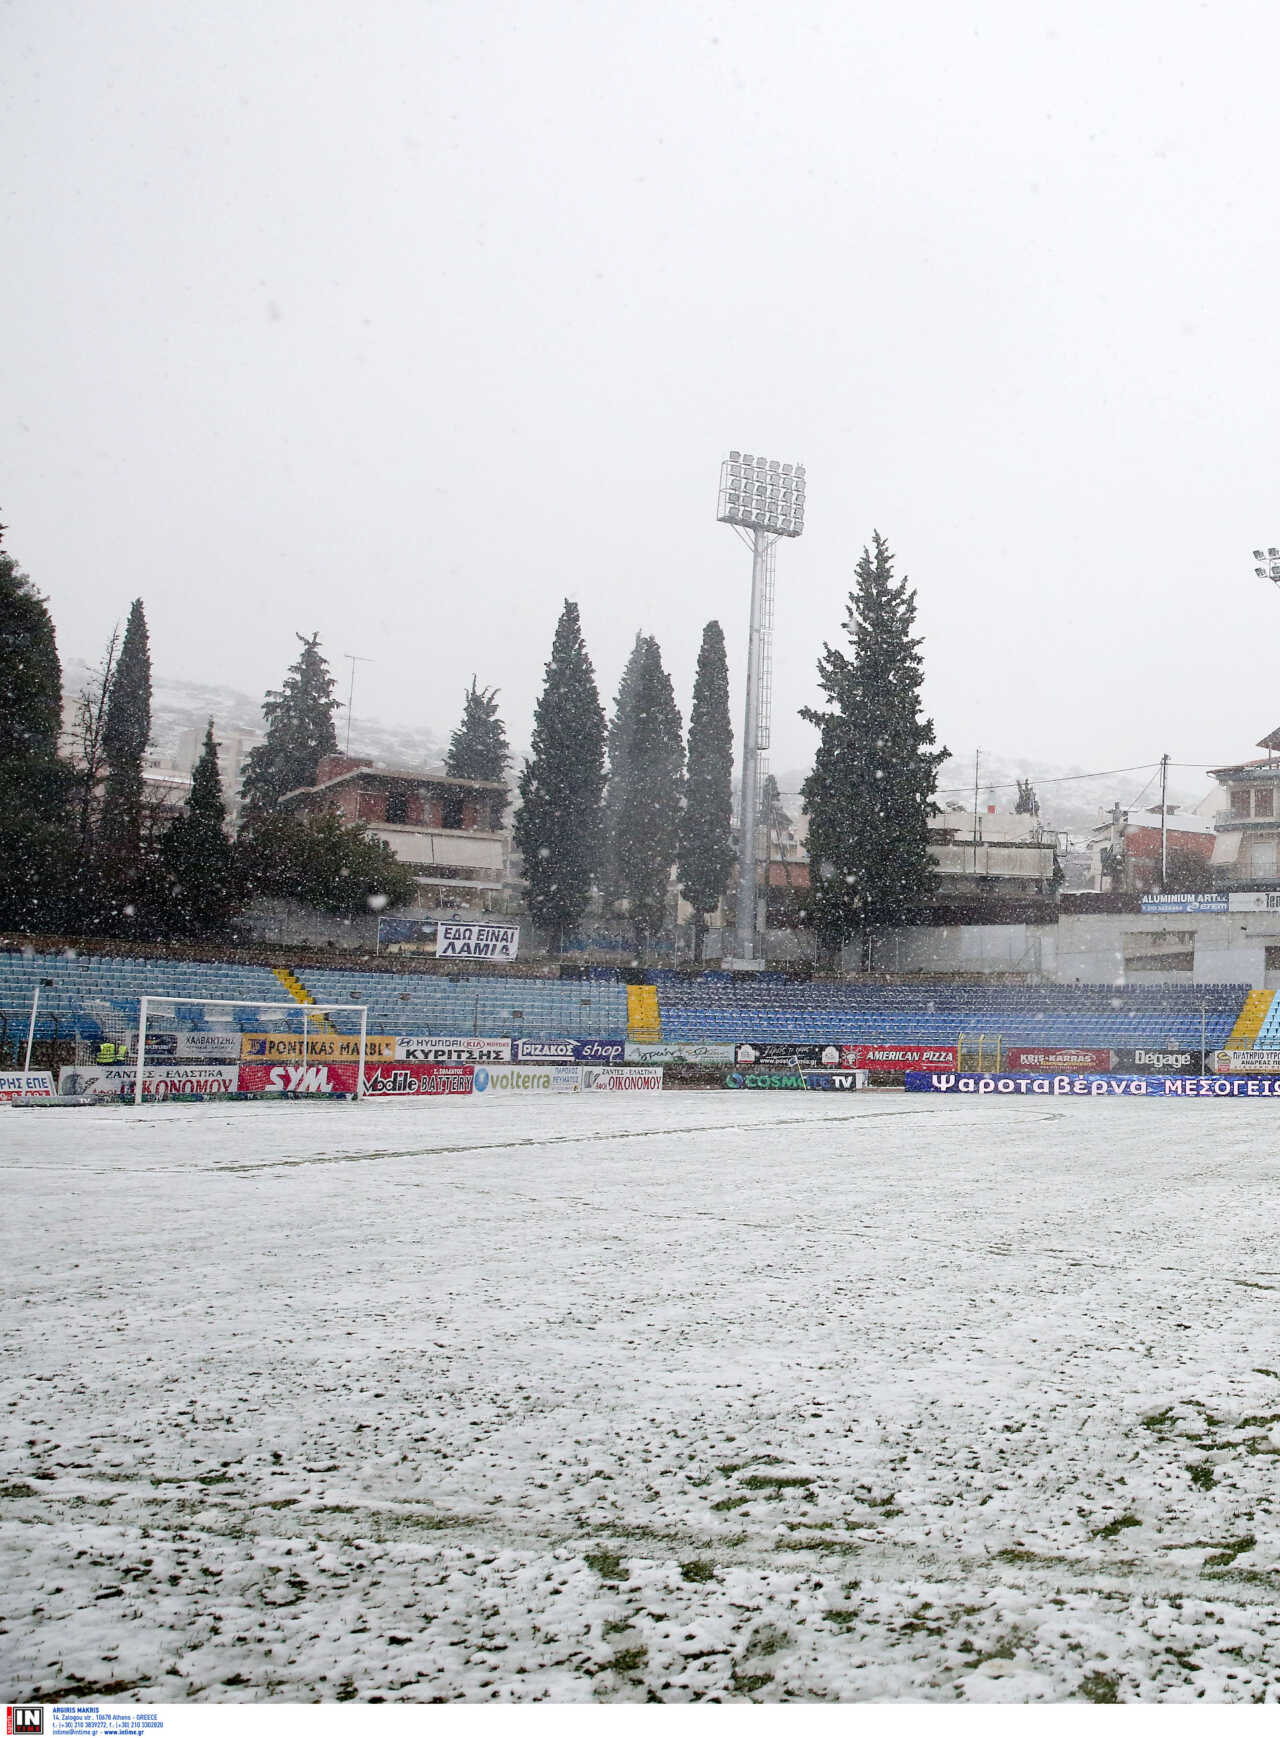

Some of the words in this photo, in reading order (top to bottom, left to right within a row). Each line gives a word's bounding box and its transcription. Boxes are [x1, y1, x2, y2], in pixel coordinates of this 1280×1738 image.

[1142, 894, 1195, 903] ALUMINIUM
[1198, 893, 1218, 902] ART
[443, 927, 473, 941] ΕΔΩ
[476, 927, 515, 943] ΕΙΝΑΙ
[268, 1040, 335, 1056] PONTIKAS
[416, 1039, 462, 1047] HYUNDAI
[522, 1045, 574, 1056] ΡΙΖΑΚΟΣ
[405, 1049, 505, 1060] ΚΥΡΙΤΣΗΣ
[582, 1044, 623, 1062] shop
[866, 1050, 921, 1062] AMERICAN
[922, 1051, 954, 1062] PIZZA
[165, 1069, 223, 1079] ΕΛΑΣΤΙΚΑ
[265, 1066, 334, 1093] SYM
[490, 1070, 550, 1090] volterra
[26, 1077, 49, 1089] ΕΠΕ
[420, 1075, 474, 1092] BATTERY
[608, 1075, 662, 1091] ΟΙΚΟΝΟΜΟΥ
[832, 1075, 854, 1089] TV
[931, 1074, 1147, 1096] Ψαροταβέρνα
